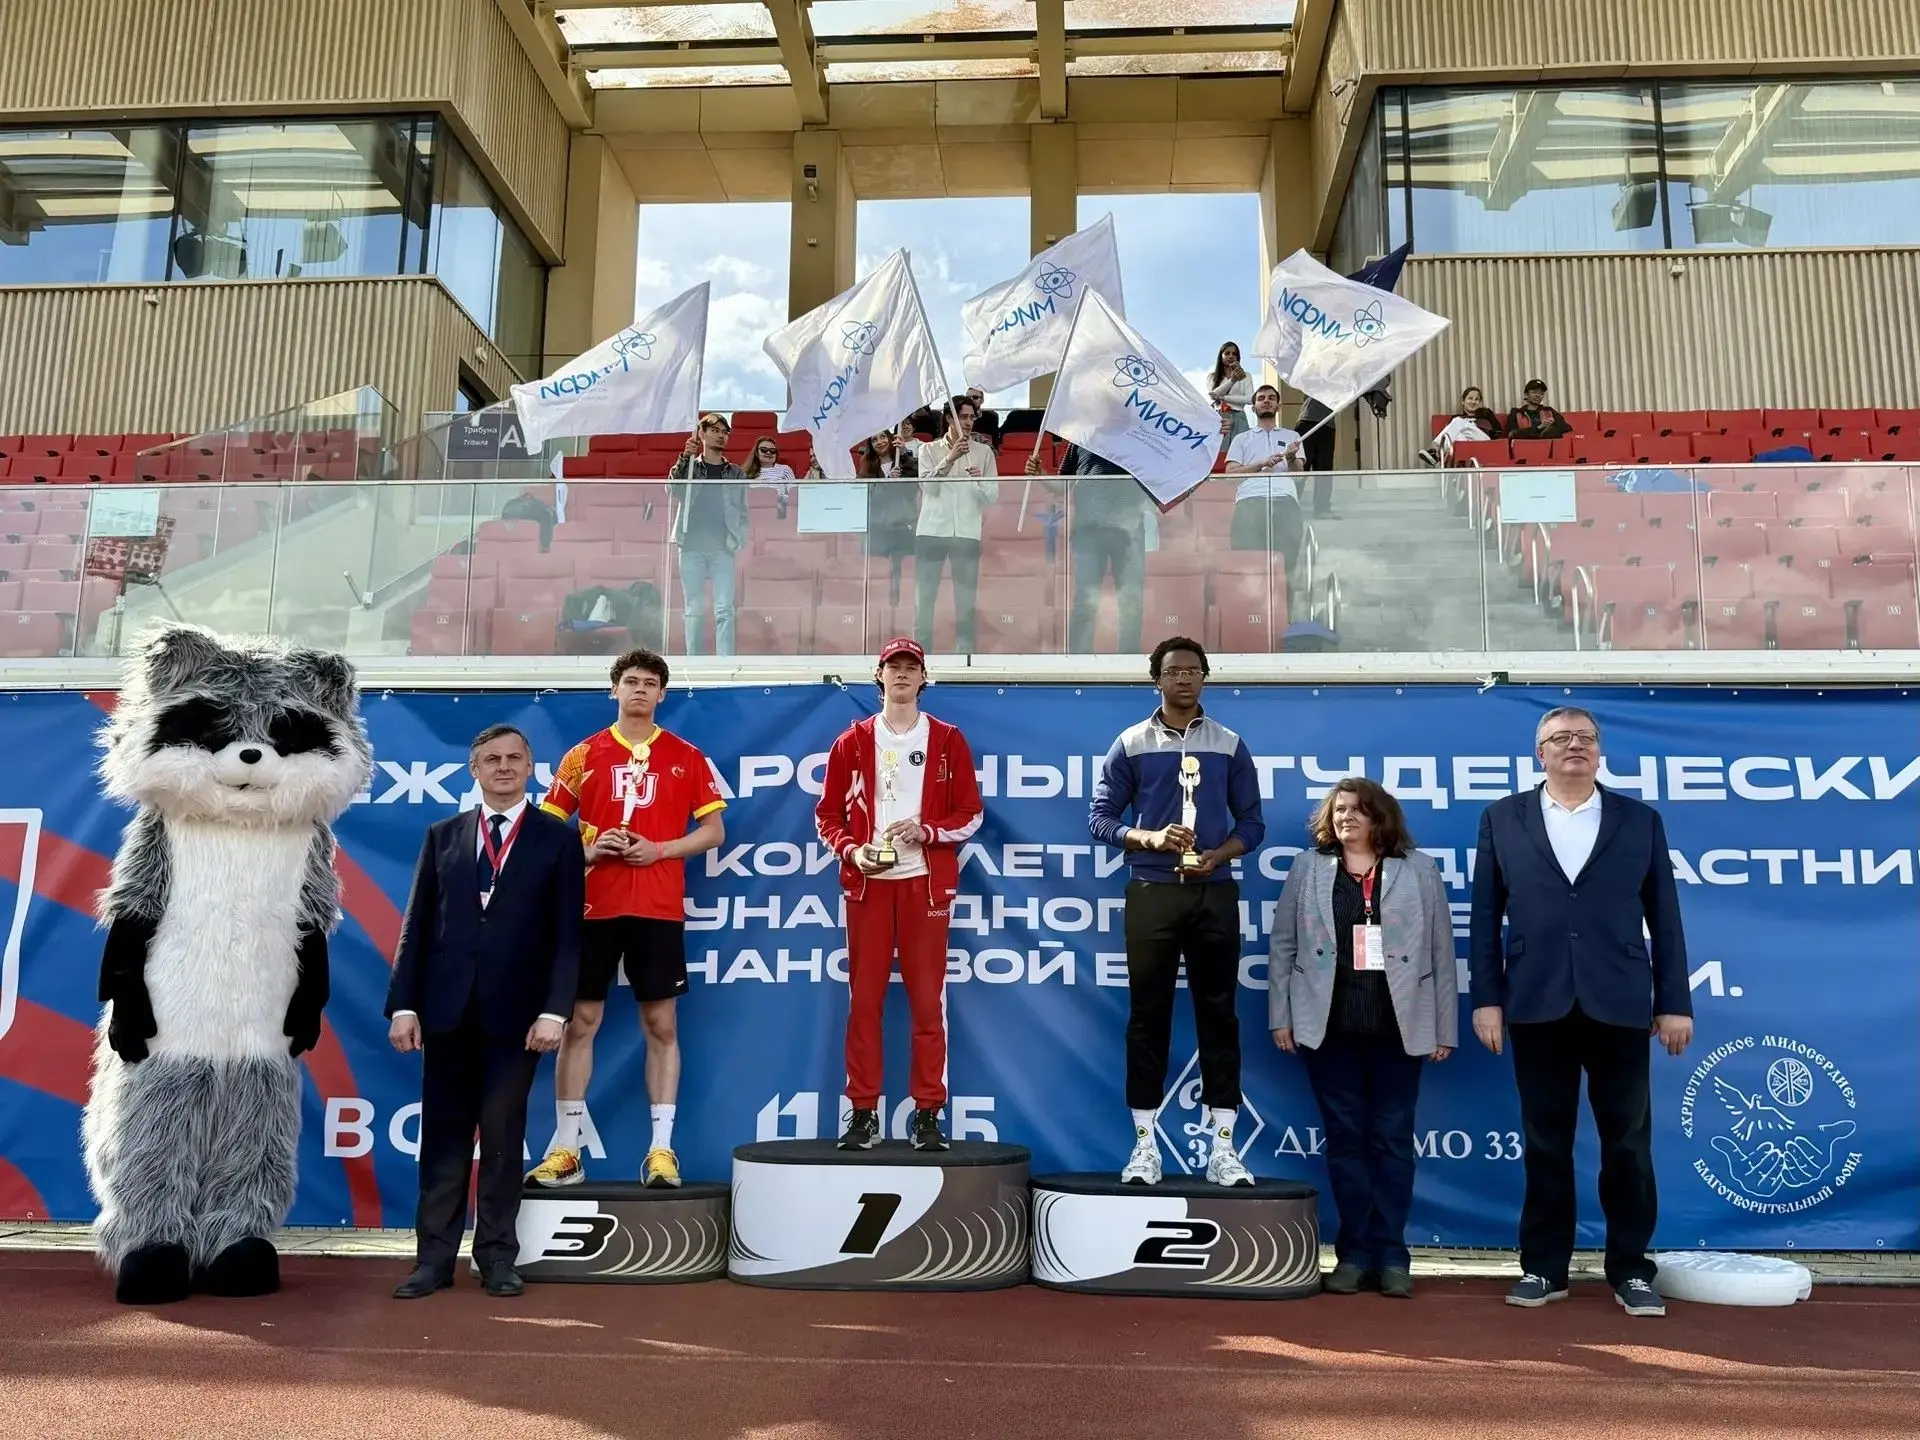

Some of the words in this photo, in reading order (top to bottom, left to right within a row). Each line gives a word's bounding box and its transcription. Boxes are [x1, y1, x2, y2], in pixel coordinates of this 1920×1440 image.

[1274, 1125, 1473, 1160] ДИМО
[1484, 1131, 1524, 1161] 33
[1835, 1151, 1864, 1188] ФОНД
[541, 1214, 618, 1260] 3
[839, 1192, 902, 1257] 1
[1133, 1219, 1222, 1269] 2
